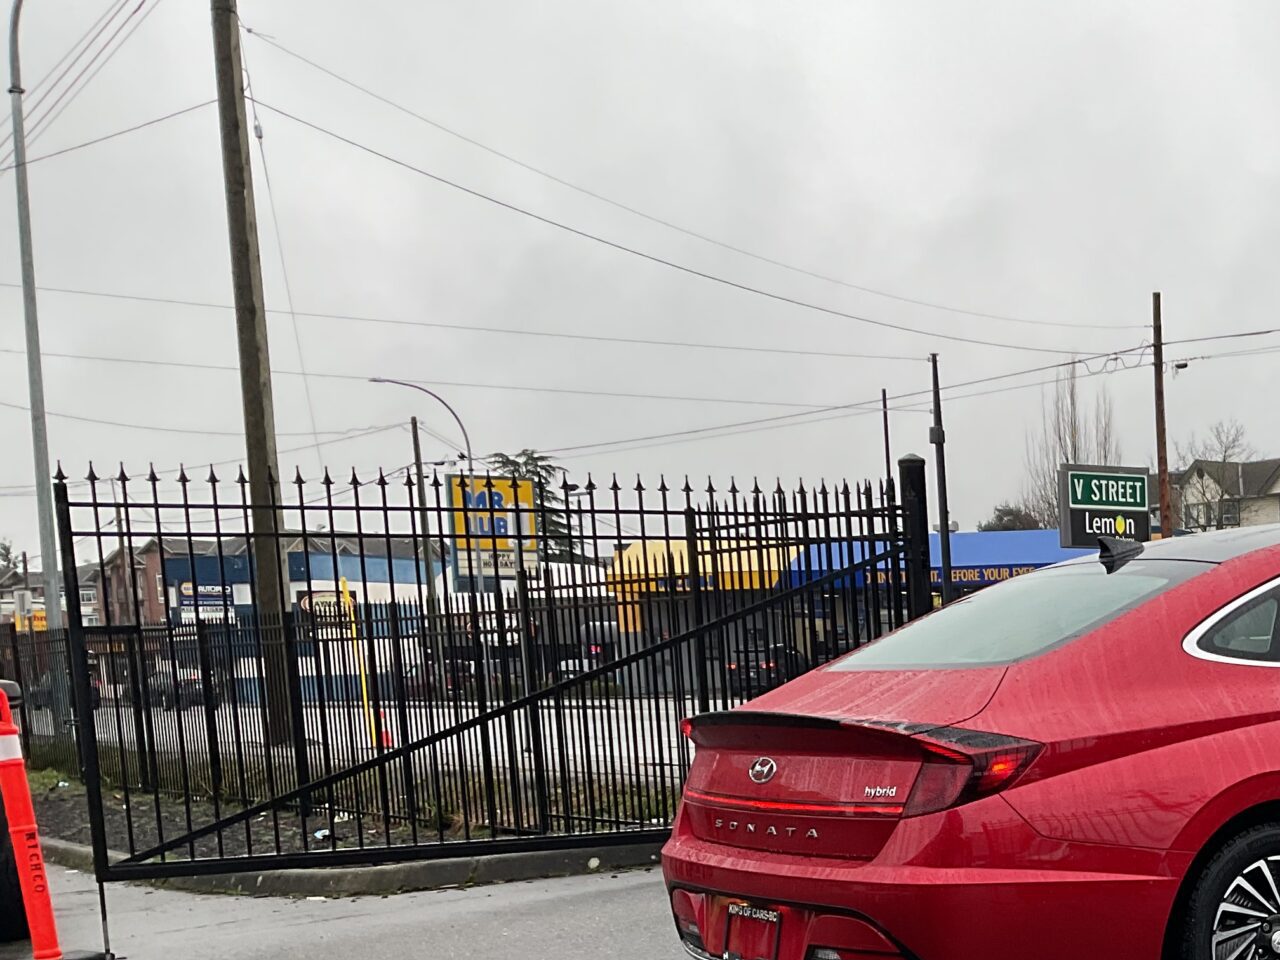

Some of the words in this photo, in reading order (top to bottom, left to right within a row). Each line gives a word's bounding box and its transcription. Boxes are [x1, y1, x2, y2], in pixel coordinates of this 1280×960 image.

[1074, 478, 1084, 500] V
[1091, 479, 1143, 503] STREET
[1085, 511, 1135, 535] Lemon
[951, 567, 981, 582] EFORE
[982, 567, 1010, 581] YOUR
[864, 786, 897, 799] hybrid
[714, 818, 818, 839] SONATA
[743, 907, 752, 917] OF
